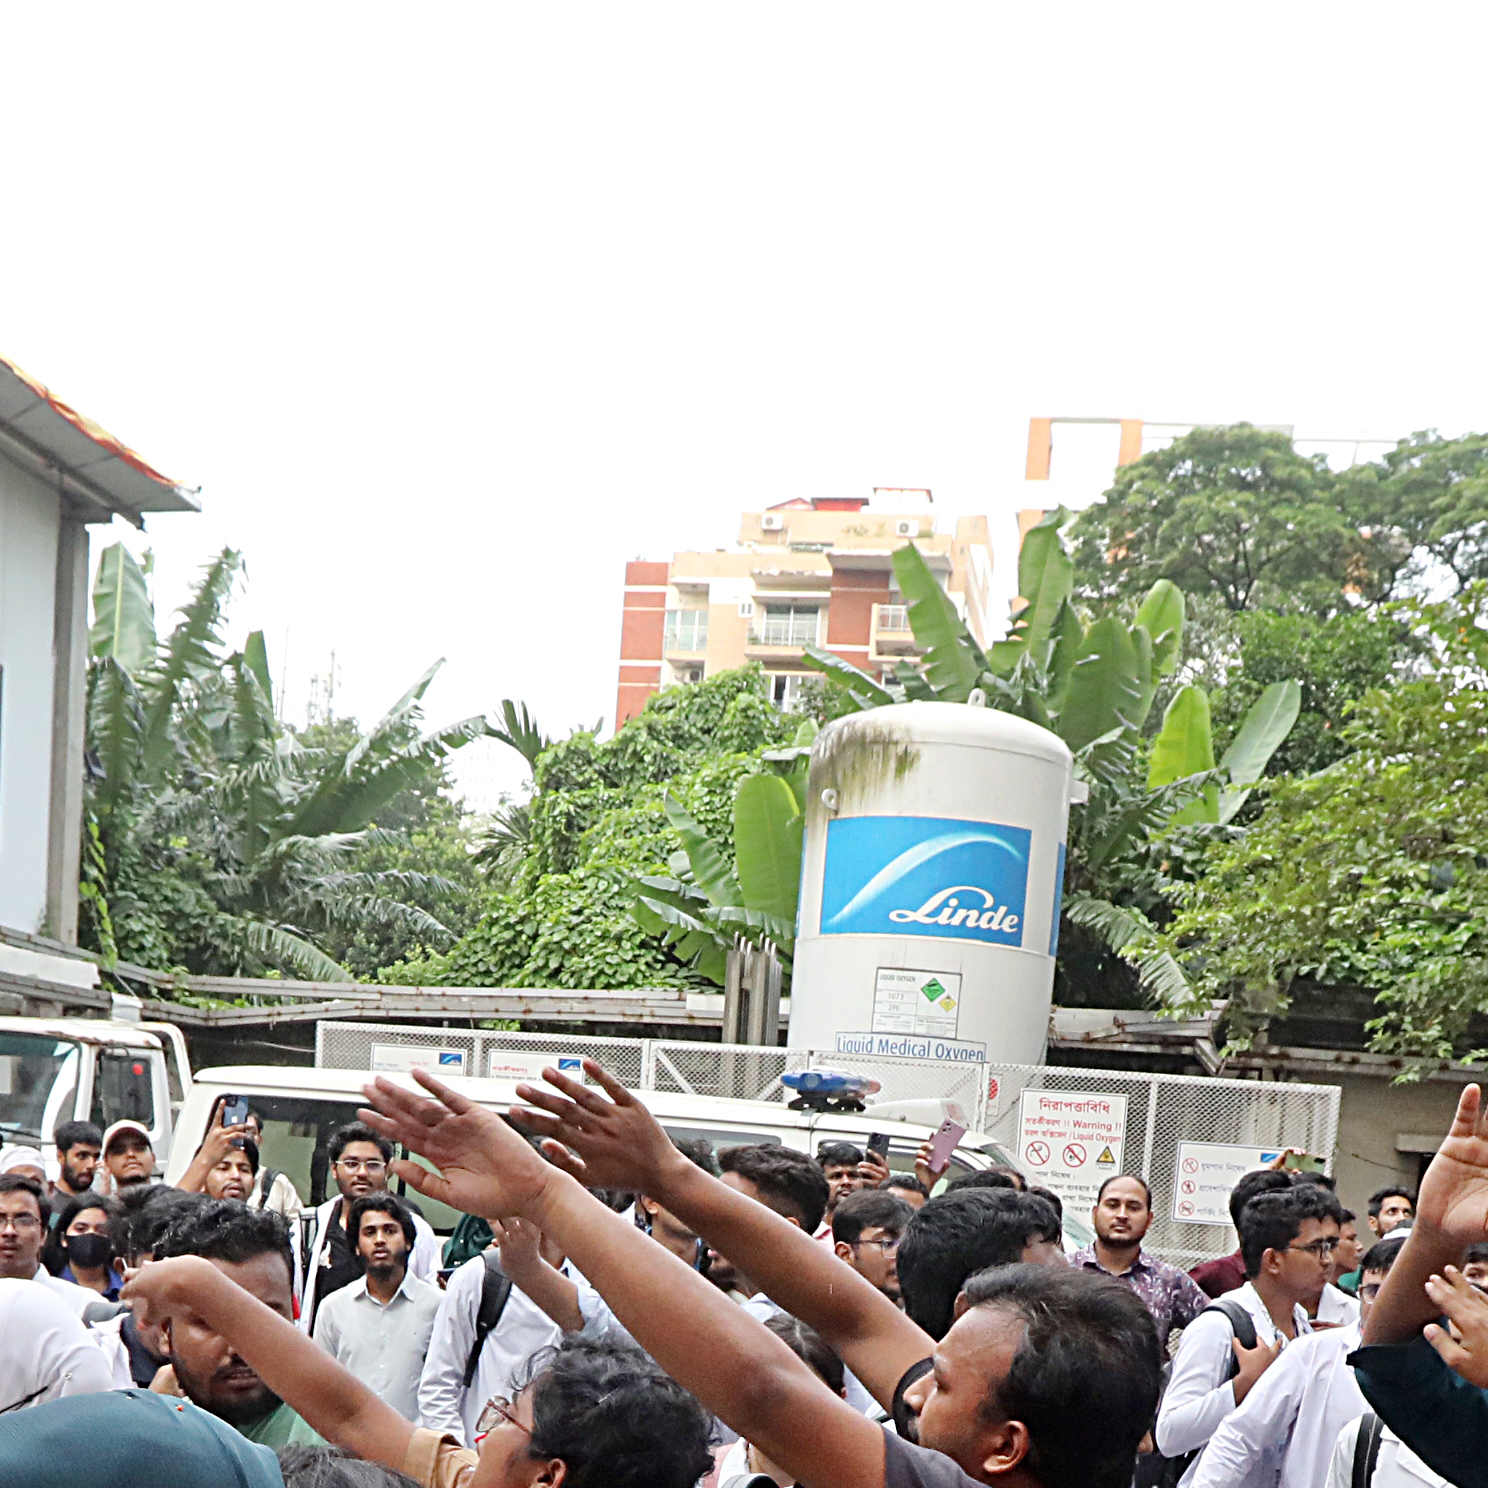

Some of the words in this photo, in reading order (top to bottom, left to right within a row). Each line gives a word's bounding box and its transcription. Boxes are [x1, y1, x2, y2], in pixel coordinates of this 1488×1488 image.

[889, 886, 1019, 933] Linde
[837, 1036, 874, 1054] Liquid
[878, 1038, 931, 1058] Medical
[935, 1043, 984, 1062] Oxygen
[1039, 1097, 1111, 1114] নিরাপত্তাবিধি
[1073, 1120, 1112, 1132] Warning
[1095, 1133, 1122, 1144] Oxygen
